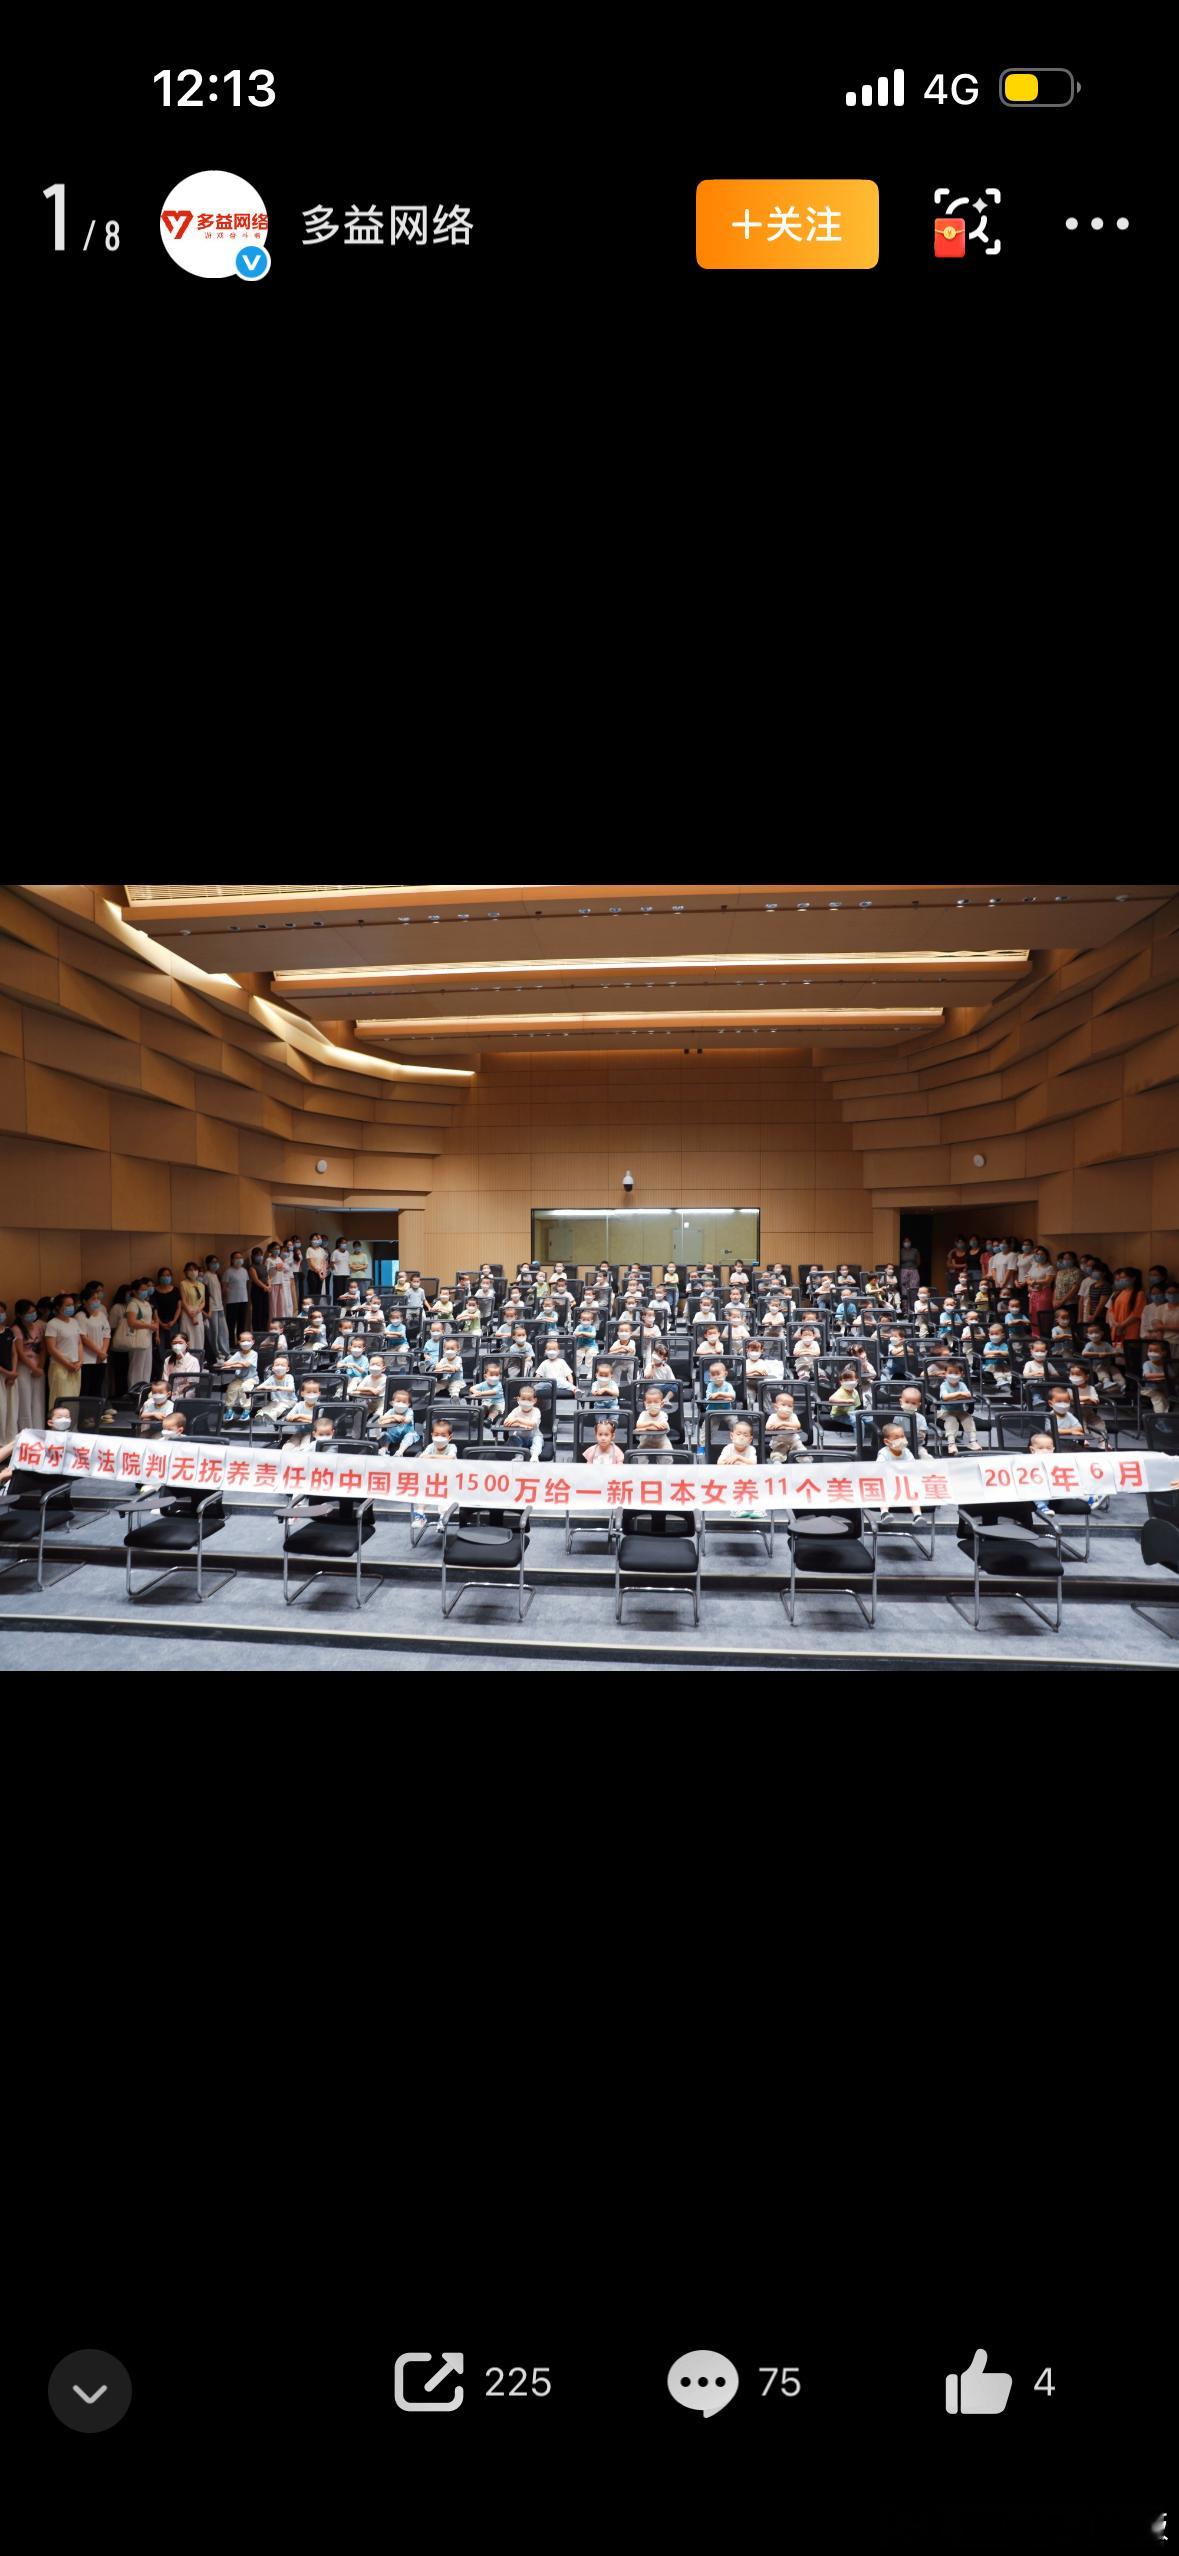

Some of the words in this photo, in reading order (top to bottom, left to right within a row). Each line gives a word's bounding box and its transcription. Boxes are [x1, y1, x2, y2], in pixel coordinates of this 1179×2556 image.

[153, 68, 276, 108] 12:13
[923, 73, 979, 105] 4G
[197, 213, 269, 230] 多益网络
[302, 204, 474, 246] 多益网络
[485, 2366, 552, 2397] 225
[758, 2367, 801, 2397] 75
[1033, 2367, 1056, 2396] 4
